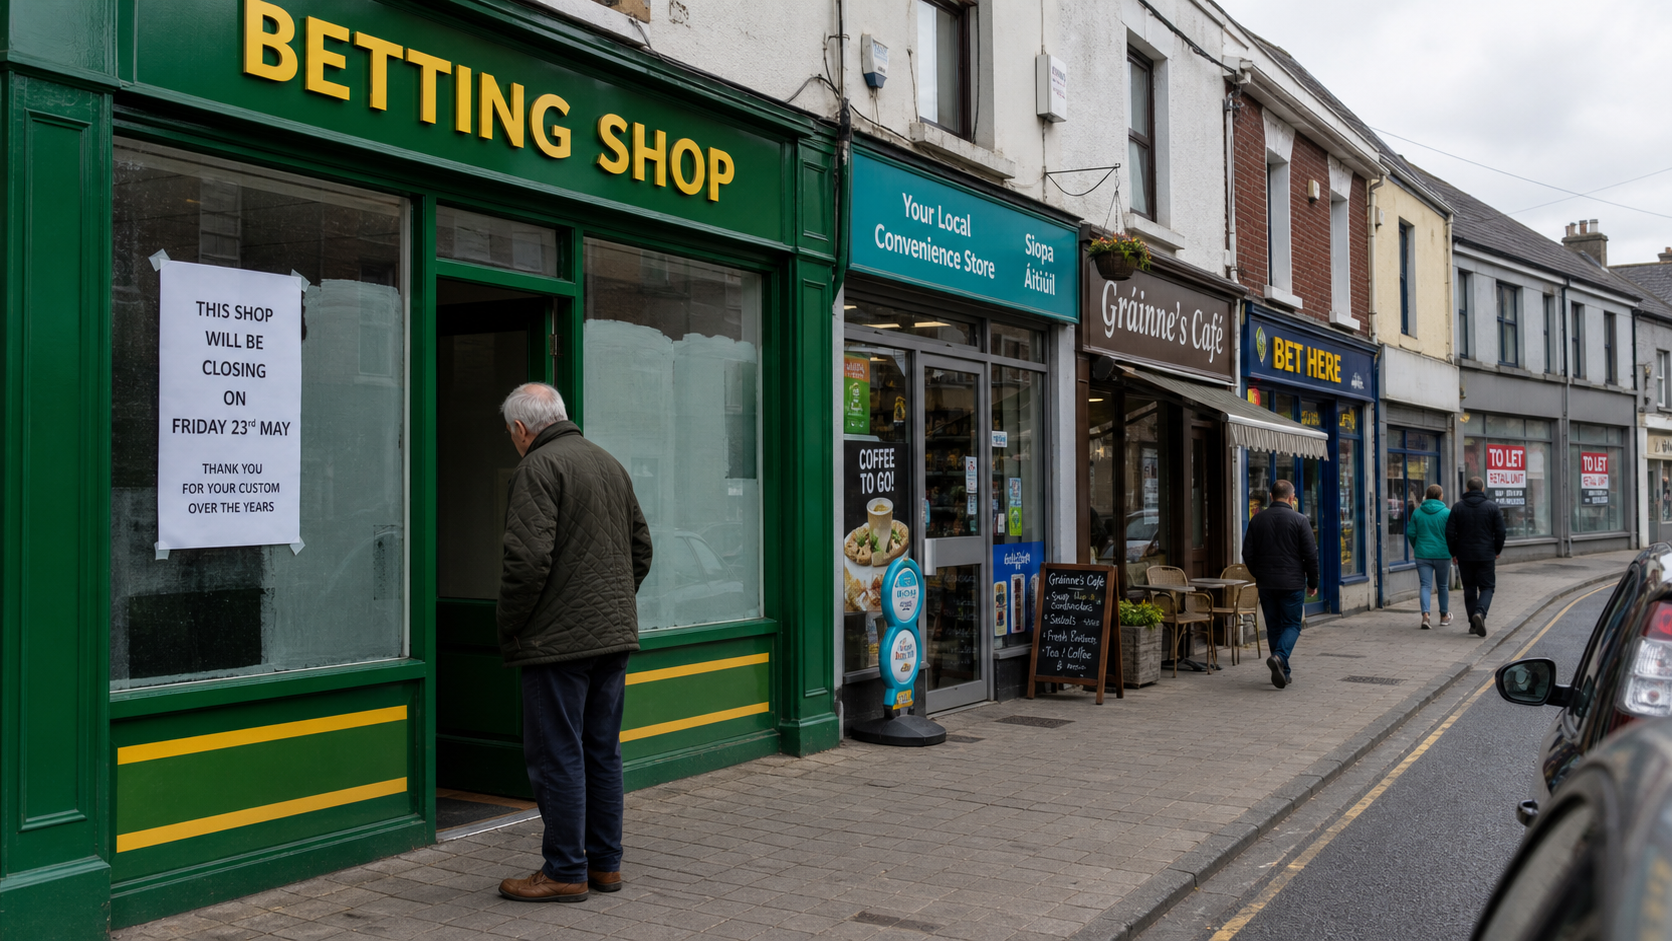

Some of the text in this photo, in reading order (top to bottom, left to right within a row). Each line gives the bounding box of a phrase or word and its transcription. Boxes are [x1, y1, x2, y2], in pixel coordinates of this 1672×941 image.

[243, 0, 735, 202] BETTING SHOP
[902, 192, 971, 237] Your Local
[874, 223, 995, 279] Convenience Store
[1025, 233, 1054, 265] Siopa
[196, 301, 273, 322] THIS SHOP
[1102, 280, 1223, 363] Gráinne's Café
[205, 330, 264, 350] WILL BE
[202, 359, 266, 378] CLOSING
[1273, 336, 1303, 374] BET
[1306, 346, 1341, 384] HERE
[223, 390, 246, 406] ON
[172, 418, 291, 436] FRIDAY 23rd MAY
[859, 447, 895, 470] COFFEE
[1489, 448, 1523, 468] TO LET
[1583, 455, 1607, 472] TO LET
[202, 463, 263, 475] THANK YOU
[182, 482, 280, 494] FOR YOUR CUSTOM
[859, 471, 895, 495] TO GO!
[188, 501, 275, 514] OVER THE YEARS
